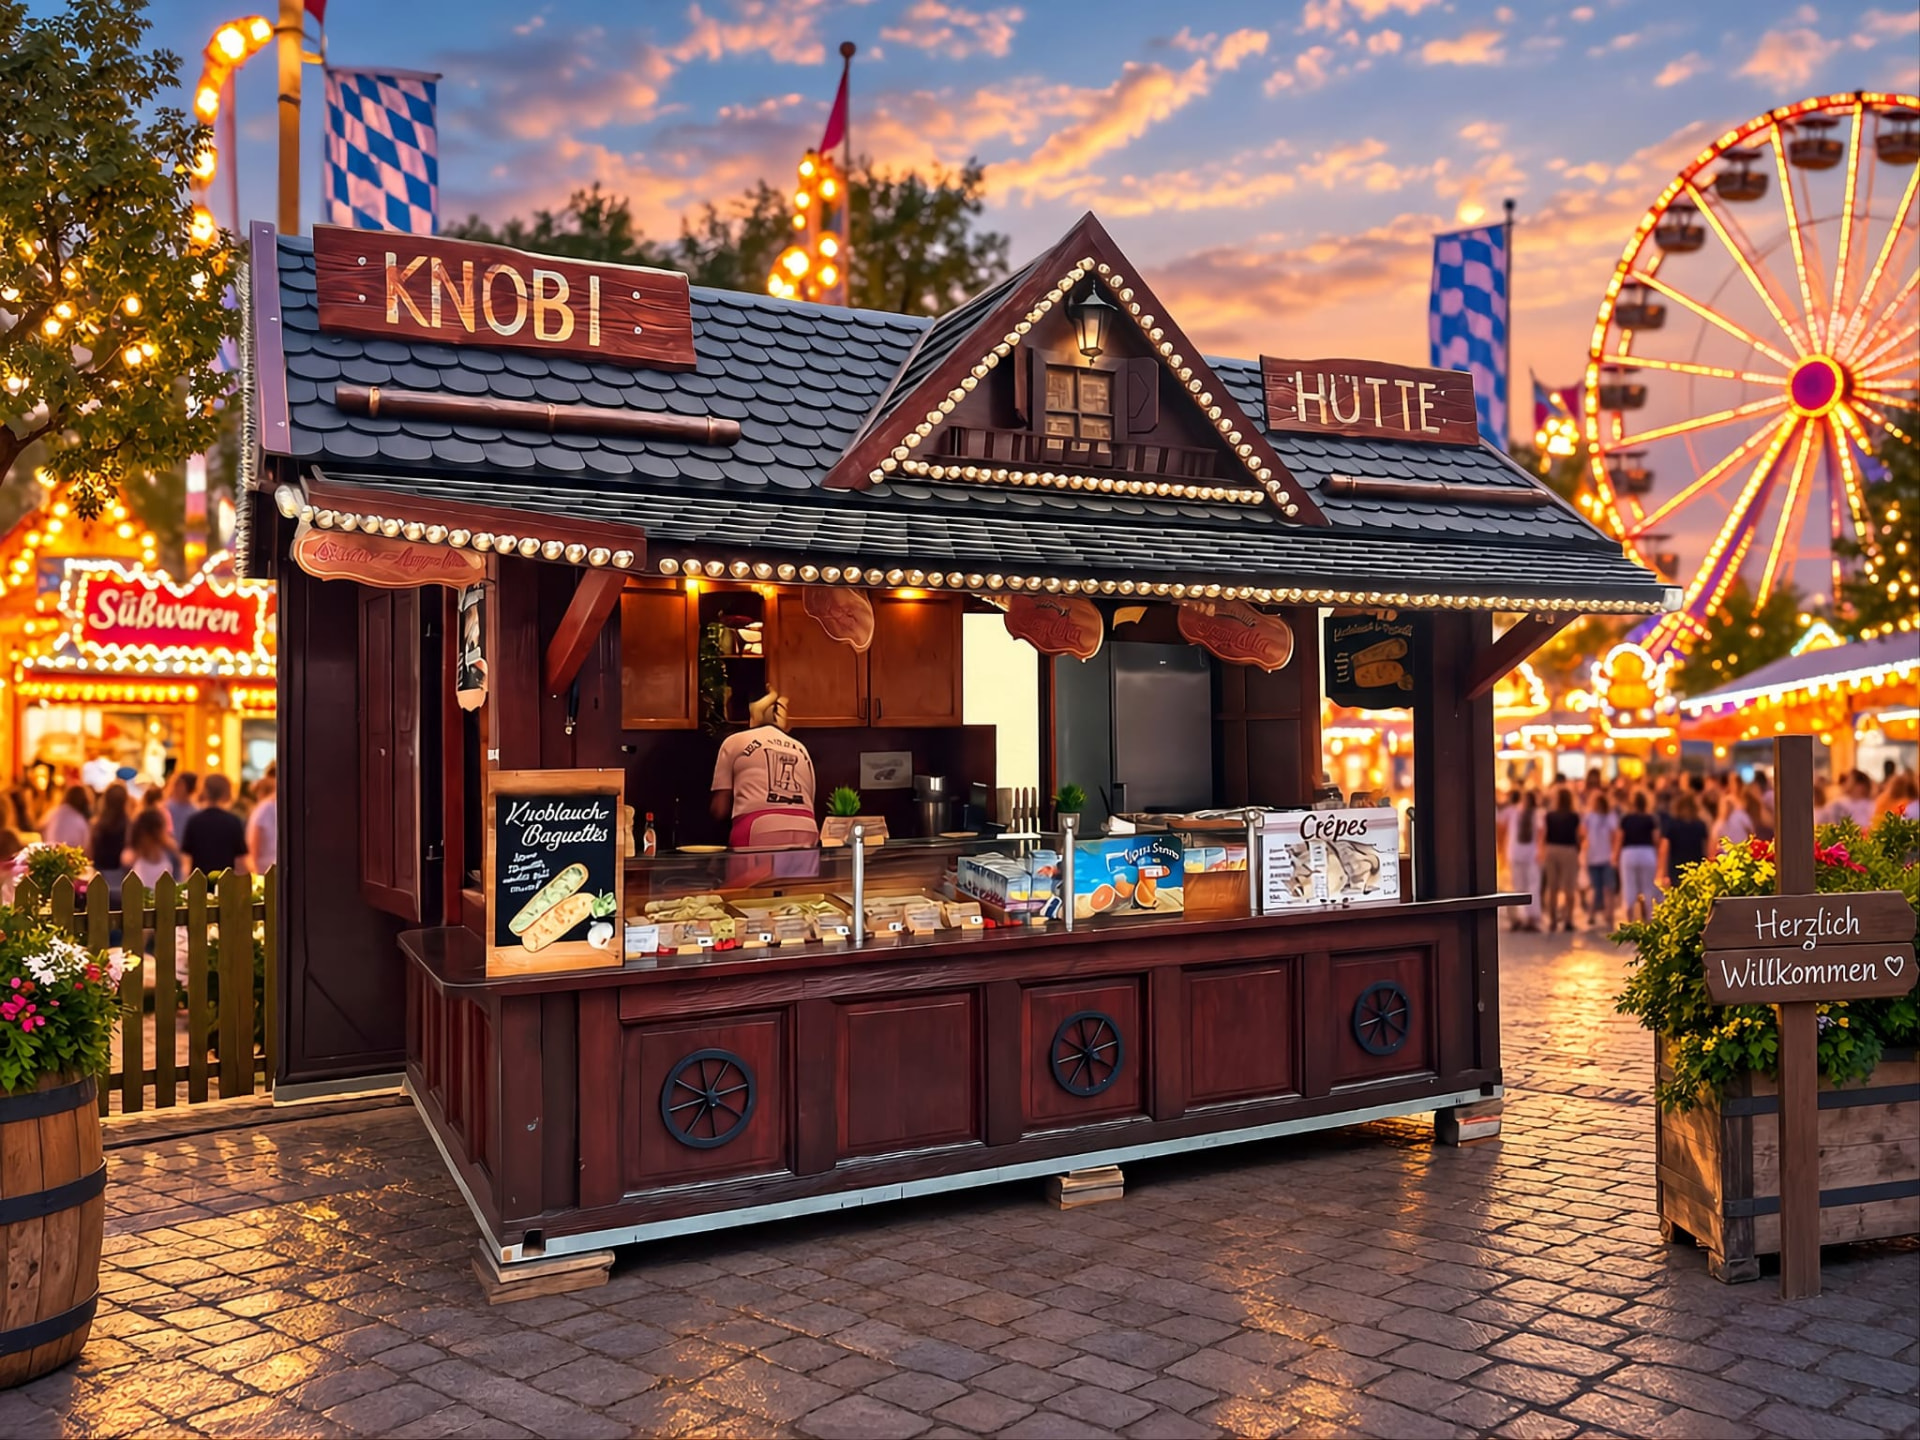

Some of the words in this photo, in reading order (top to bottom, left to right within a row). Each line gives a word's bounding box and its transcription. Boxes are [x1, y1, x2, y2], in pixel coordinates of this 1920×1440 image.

[385, 252, 600, 347] KNOBI
[1295, 370, 1441, 434] HÜTTE
[88, 588, 240, 635] Süßwaren
[521, 822, 609, 852] Baguettes
[1300, 813, 1368, 842] Crêpes
[1755, 905, 1860, 951] Herzlich
[1720, 957, 1879, 989] Willkommen
